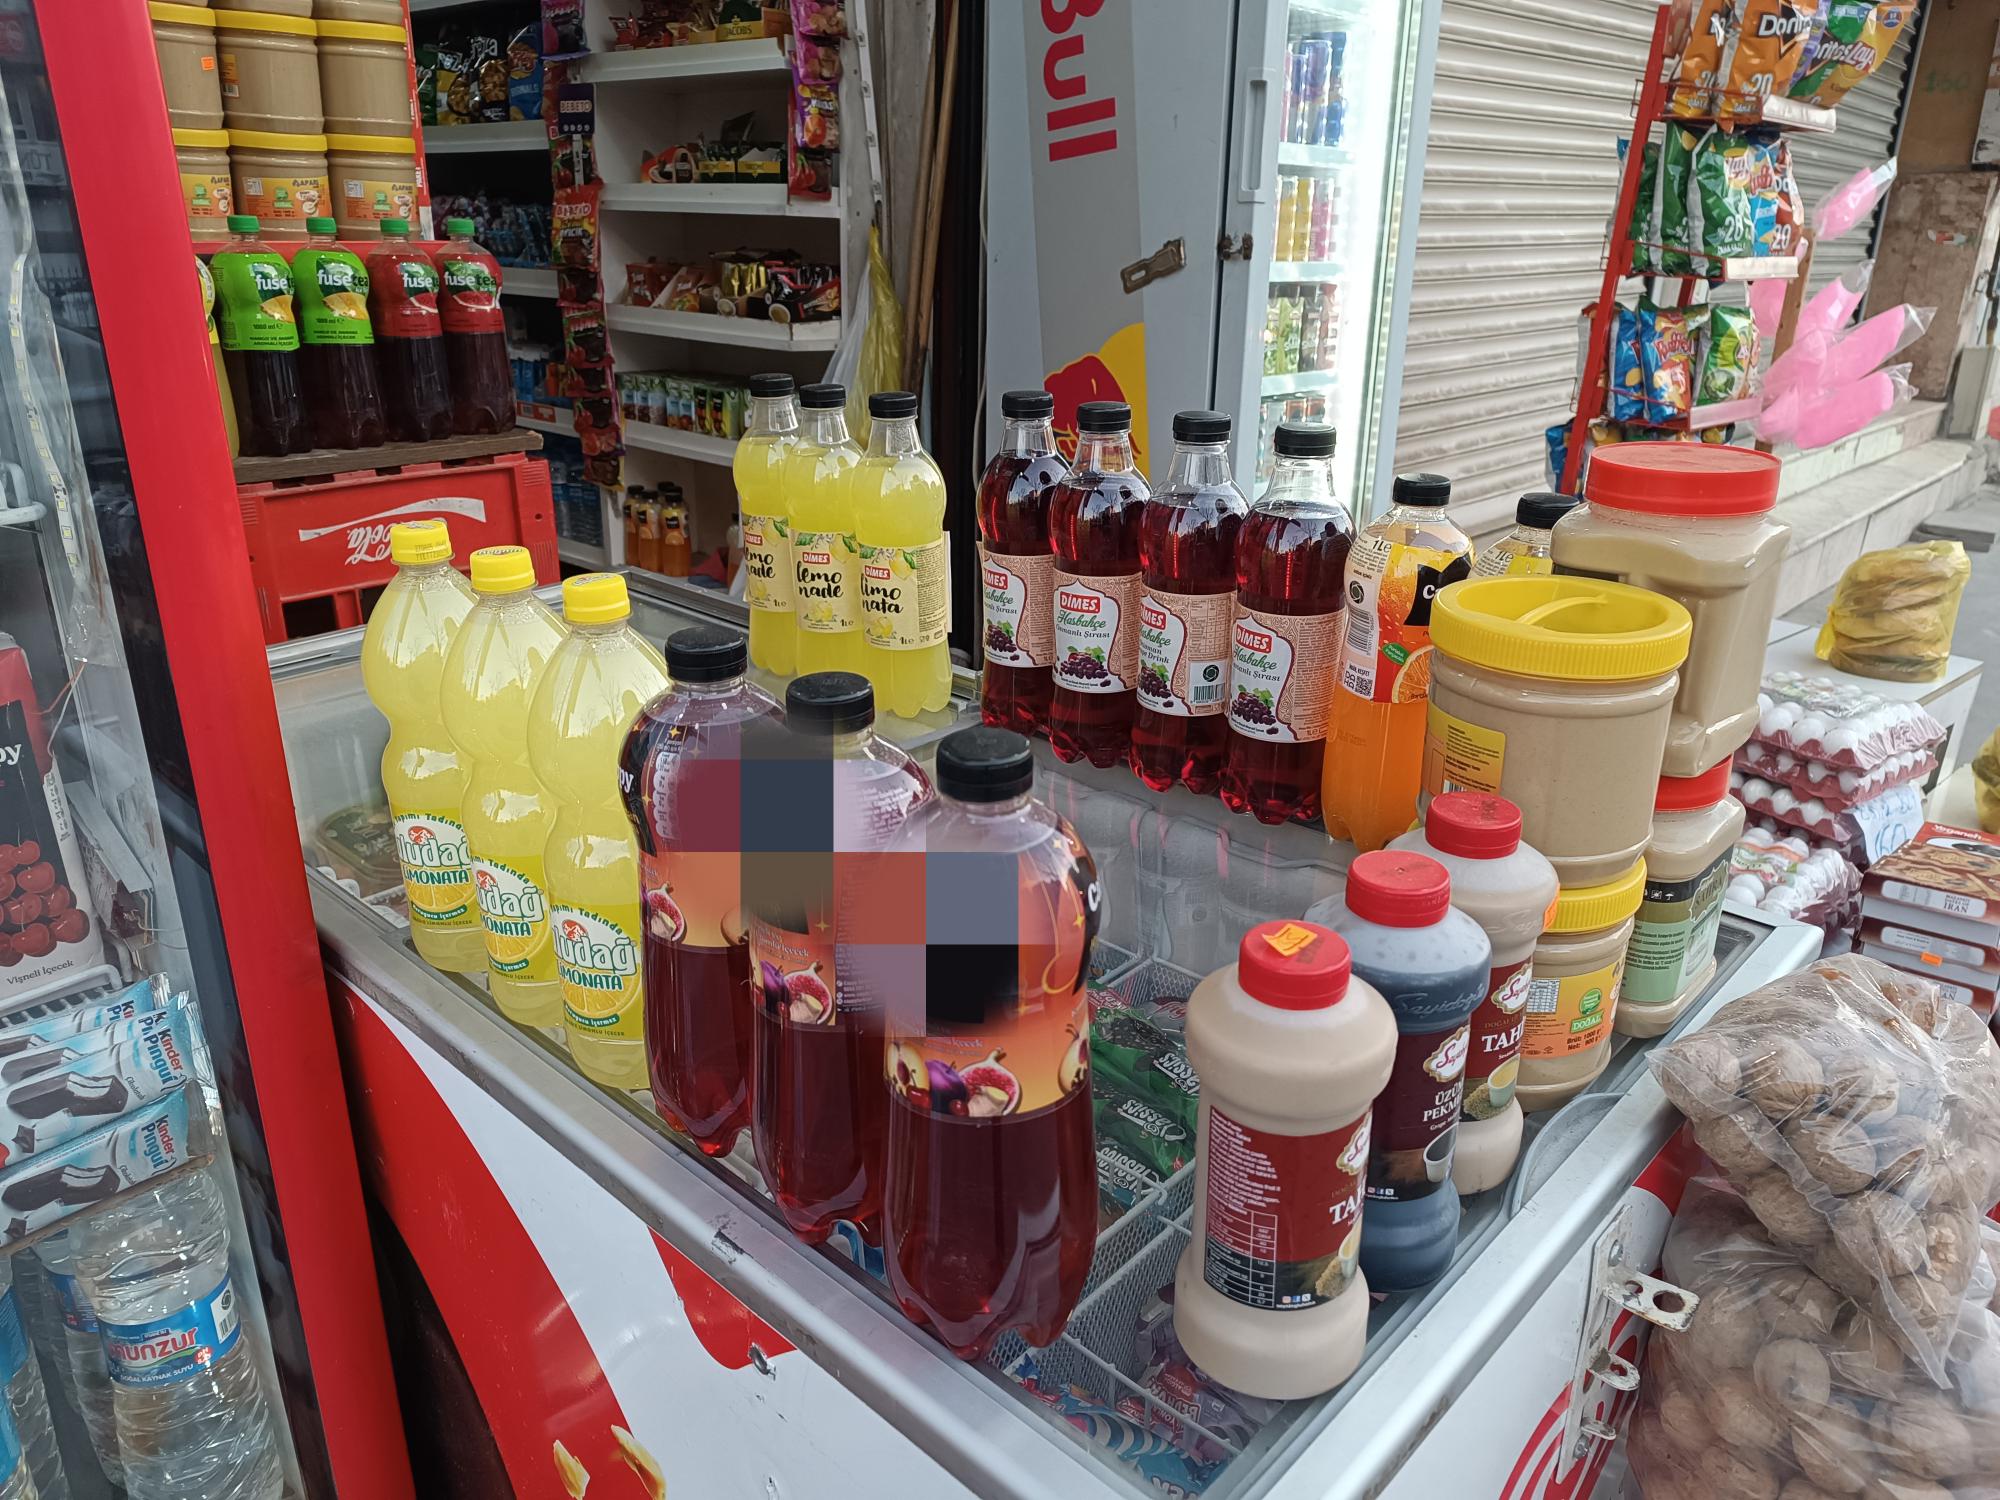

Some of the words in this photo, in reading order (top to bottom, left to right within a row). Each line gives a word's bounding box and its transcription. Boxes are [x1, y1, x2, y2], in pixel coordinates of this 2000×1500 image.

[1943, 902, 1969, 914] IRAN
[6, 967, 42, 986] Vişneli
[43, 959, 75, 977] İçecek
[157, 1028, 183, 1072] Kinder
[155, 1114, 176, 1156] Kinder
[1118, 1098, 1187, 1141] Classics
[108, 1326, 199, 1361] munzur
